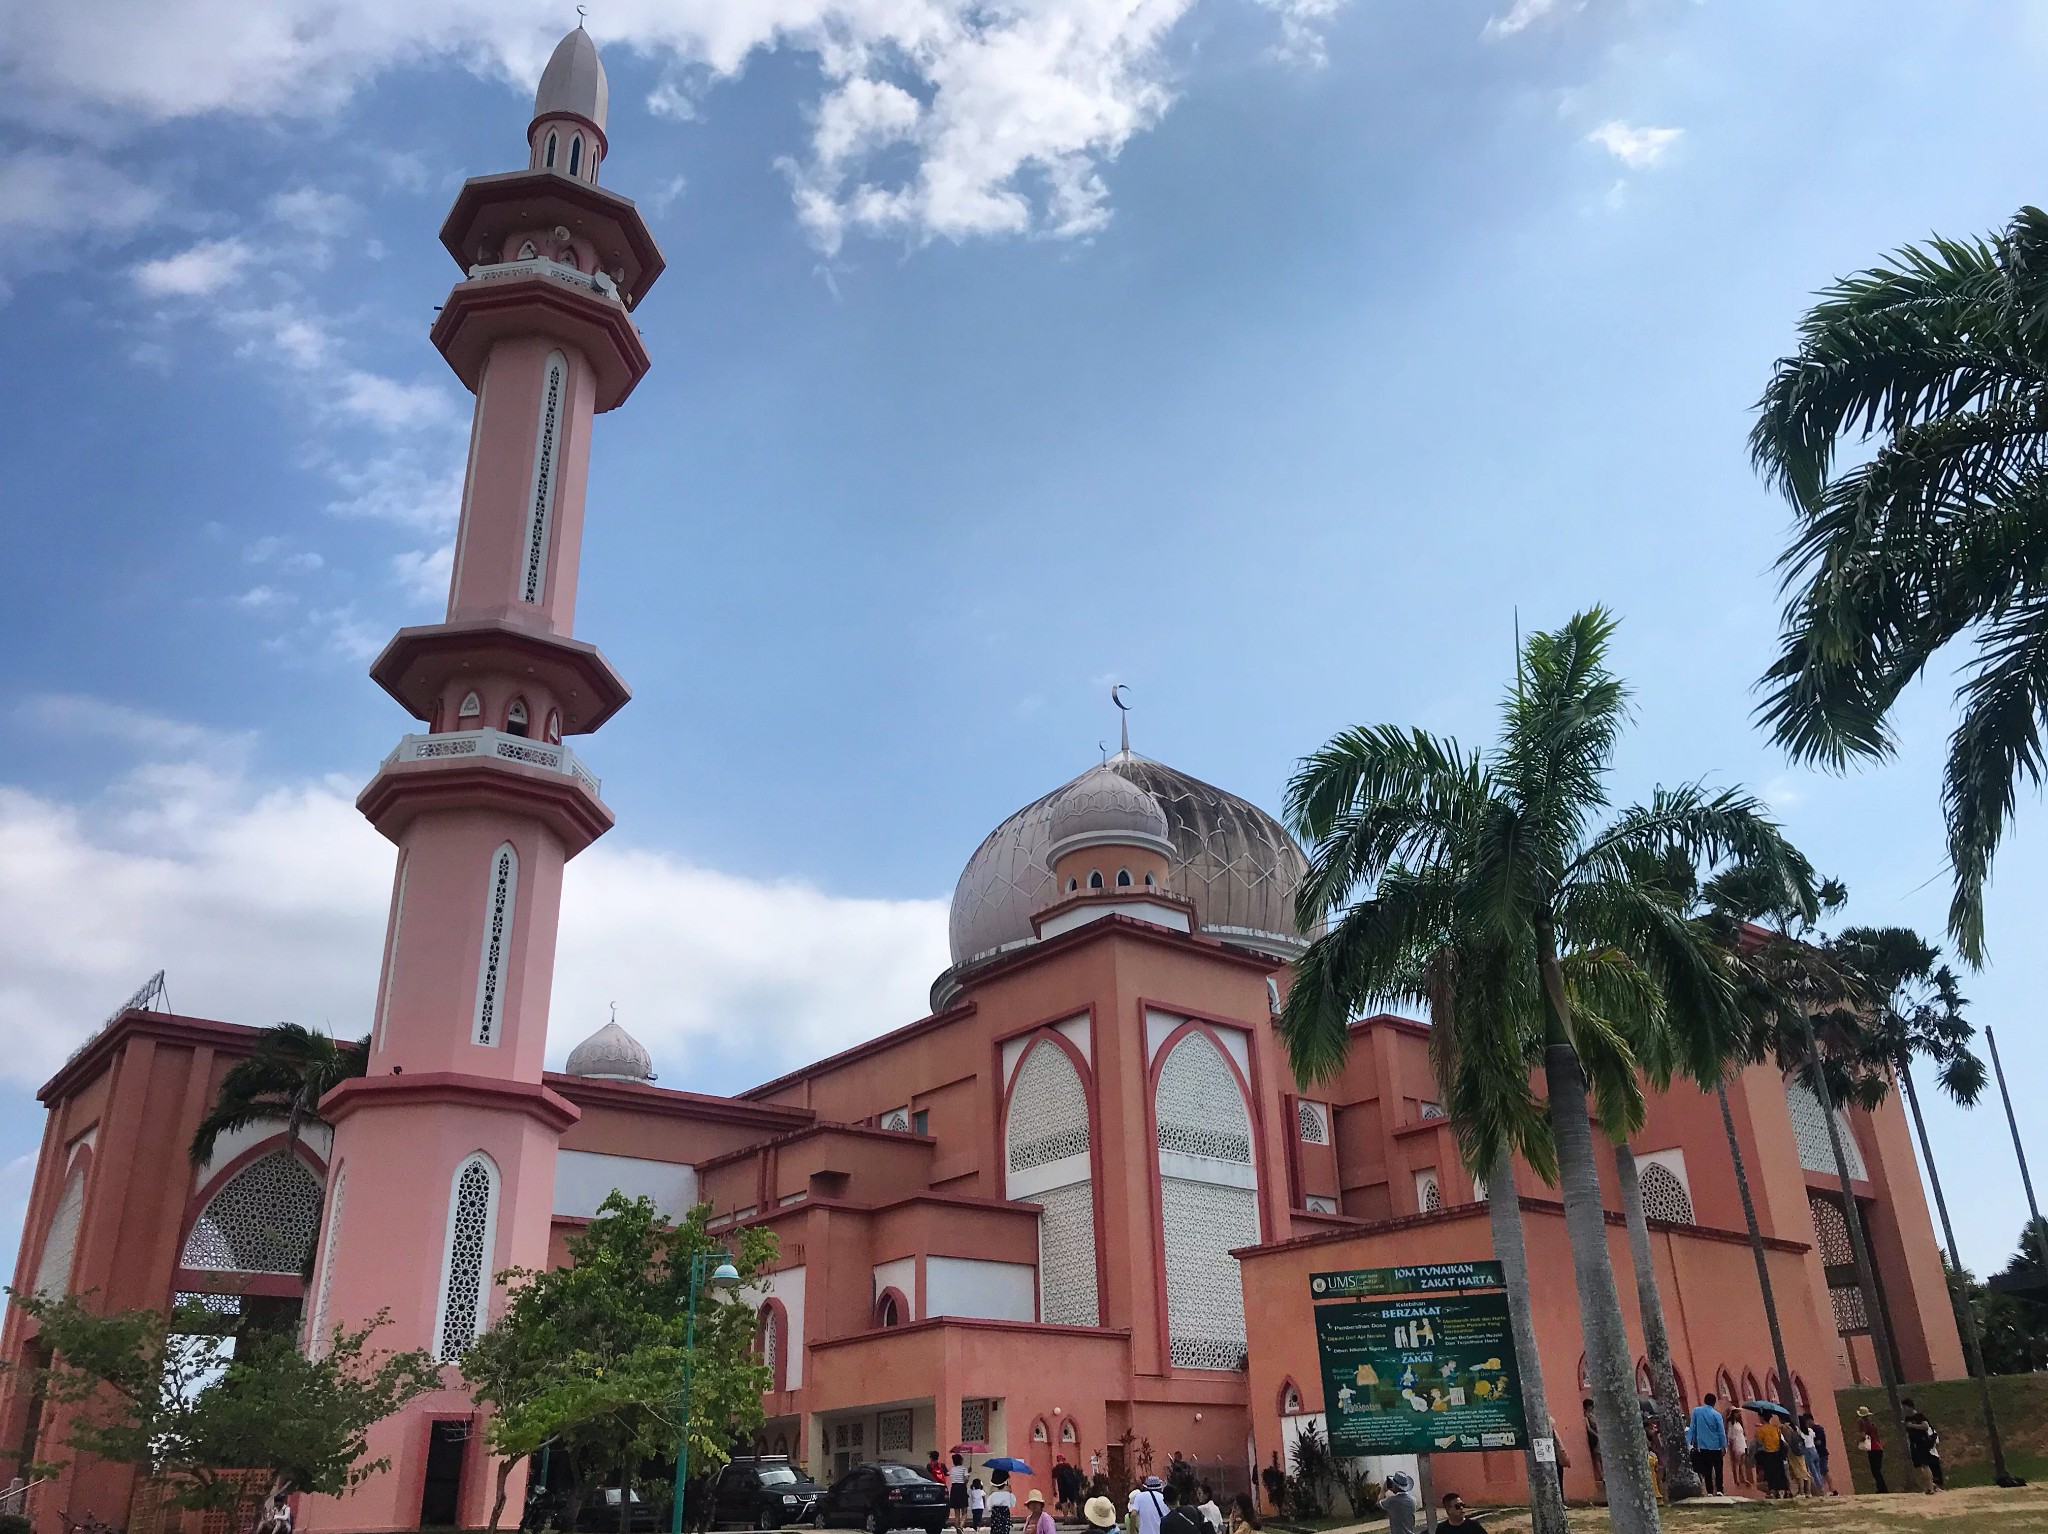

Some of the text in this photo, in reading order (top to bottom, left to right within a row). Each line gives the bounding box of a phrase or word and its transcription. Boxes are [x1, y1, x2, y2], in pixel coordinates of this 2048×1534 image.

[1395, 1265, 1473, 1280] JOM TUNAIKAN
[1327, 1276, 1356, 1288] UMS
[1421, 1275, 1494, 1289] ZAKAT HARTA
[1382, 1306, 1440, 1318] BERZAKAT
[1401, 1355, 1434, 1364] ZAKAT
